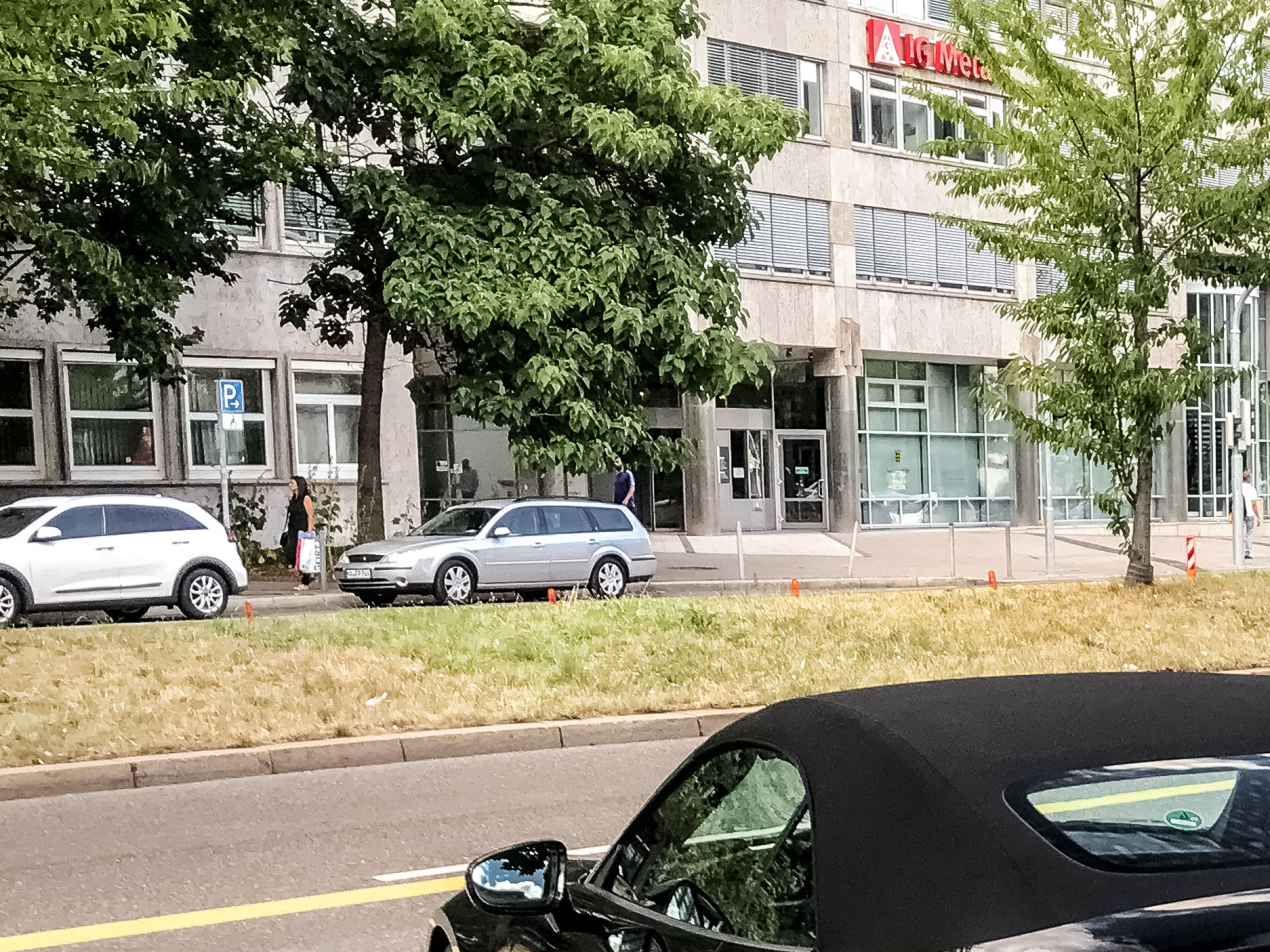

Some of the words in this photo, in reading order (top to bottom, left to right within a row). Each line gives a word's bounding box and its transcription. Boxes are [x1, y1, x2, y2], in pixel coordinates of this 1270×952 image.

[904, 33, 935, 68] IG
[934, 40, 992, 81] Meta
[223, 384, 237, 408] P
